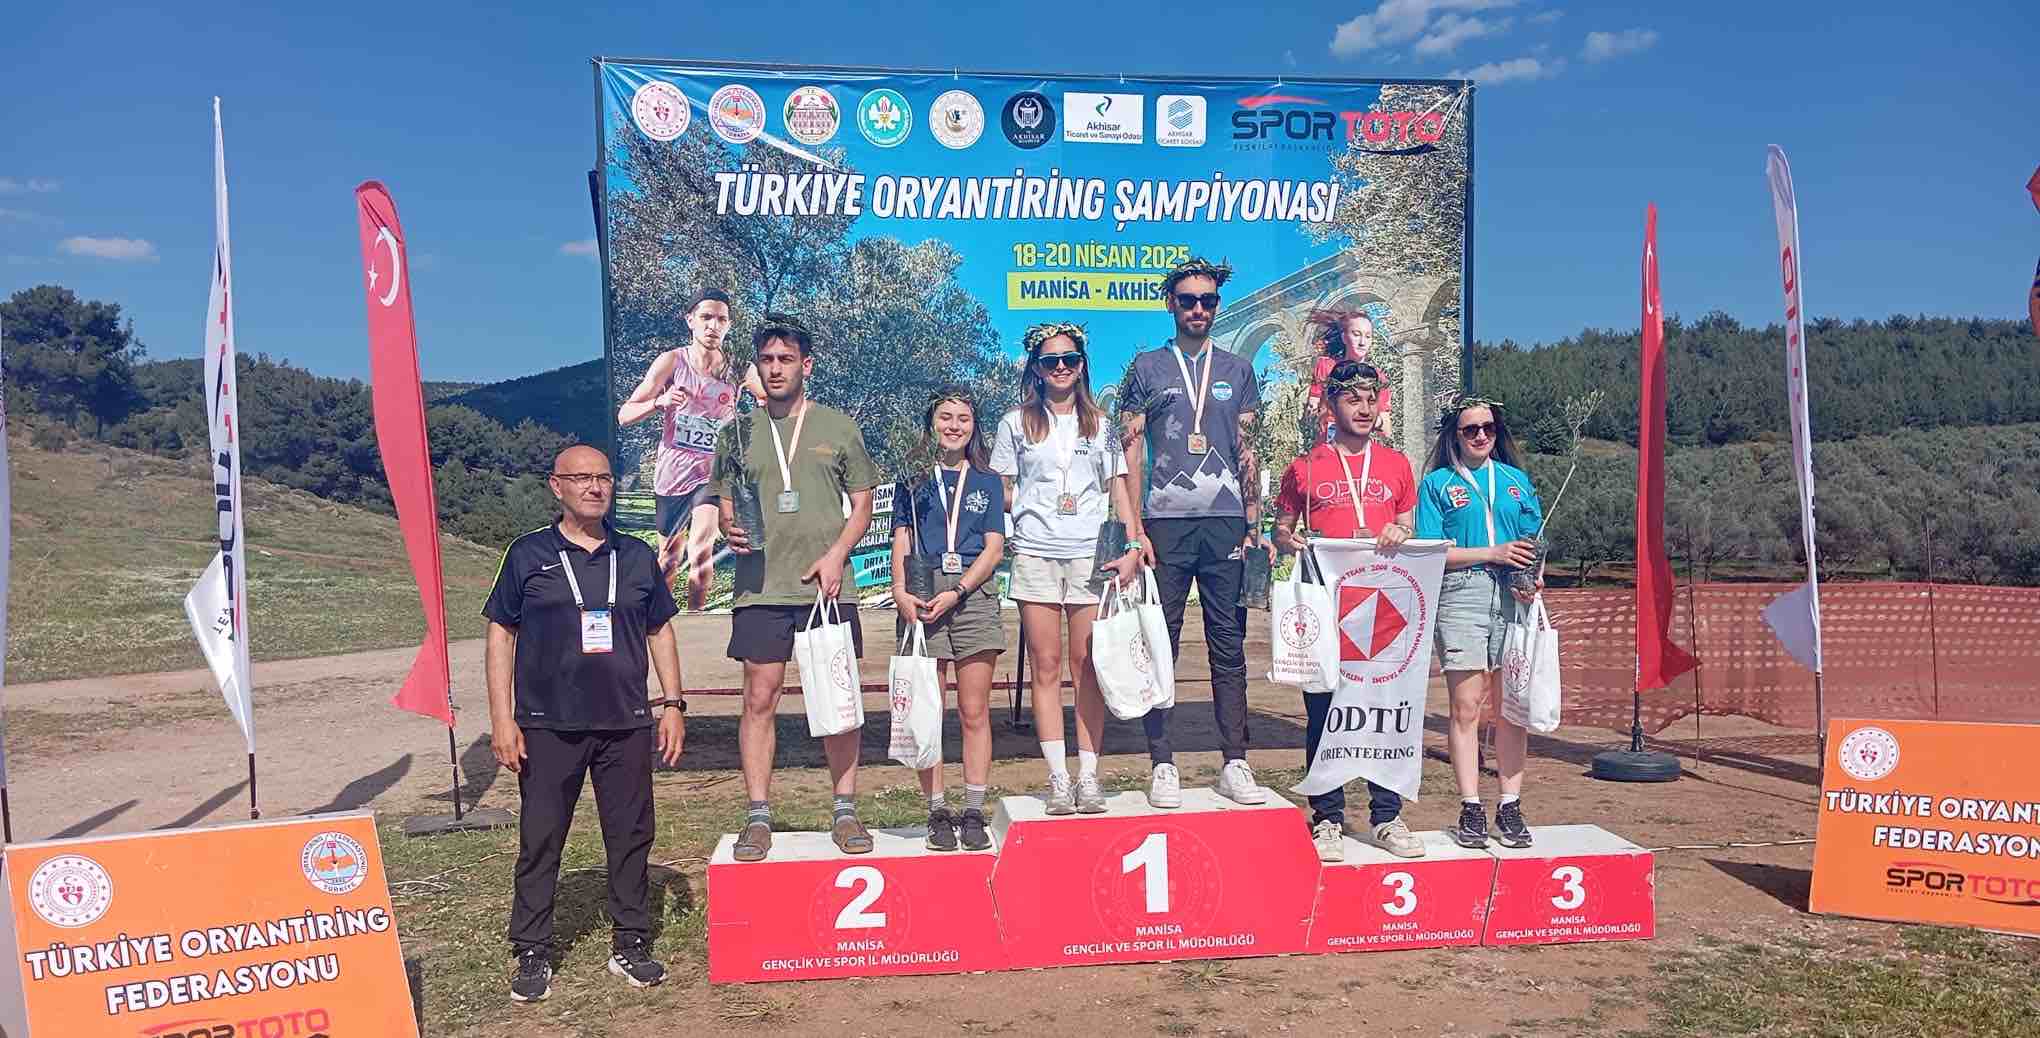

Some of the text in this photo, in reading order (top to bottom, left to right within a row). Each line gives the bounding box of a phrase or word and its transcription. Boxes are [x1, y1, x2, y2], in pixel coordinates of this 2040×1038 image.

[1086, 121, 1121, 131] Akhisar
[1231, 110, 1443, 143] SPOR TOTO
[714, 163, 1341, 232] TÜRKİYE ORYANTİRİNG ŞAMPİYONASI
[1013, 239, 1190, 269] 18-20 NİSAN 2025
[1020, 277, 1091, 300] MANİSA
[1106, 278, 1169, 301] AKHİSA
[684, 430, 714, 447] 123
[1327, 700, 1413, 734] ODTÜ
[1320, 745, 1415, 761] ORIENTEERING
[1825, 788, 1932, 818] TÜRKİYE
[1121, 832, 1170, 913] 1
[1886, 868, 1965, 892] SPOR
[833, 865, 887, 929] 2
[1381, 871, 1418, 917] 3
[1551, 865, 1586, 910] 3
[1135, 923, 1182, 936] MANİSA
[1382, 920, 1419, 931] MANİSA
[1495, 922, 1641, 940] GENÇLİK VE SPOR İL MÜDÜRLÜĞÜ
[1551, 915, 1587, 925] MANİSA
[25, 906, 390, 981] TÜRKİYE ORYANTİRİNG
[837, 940, 885, 952] MANİSA
[1063, 934, 1255, 956] GENÇLİK VE SPOR İL MÜDÜRLÜĞÜ
[1326, 928, 1474, 947] GENÇLİK VE SPOR İL MÜDÜRLÜĞÜ
[762, 950, 960, 971] GENÇLİK VE SPOR İL MÜDÜRLÜĞÜ
[105, 953, 340, 1016] FEDERASYONU
[237, 1008, 330, 1038] TOTO
